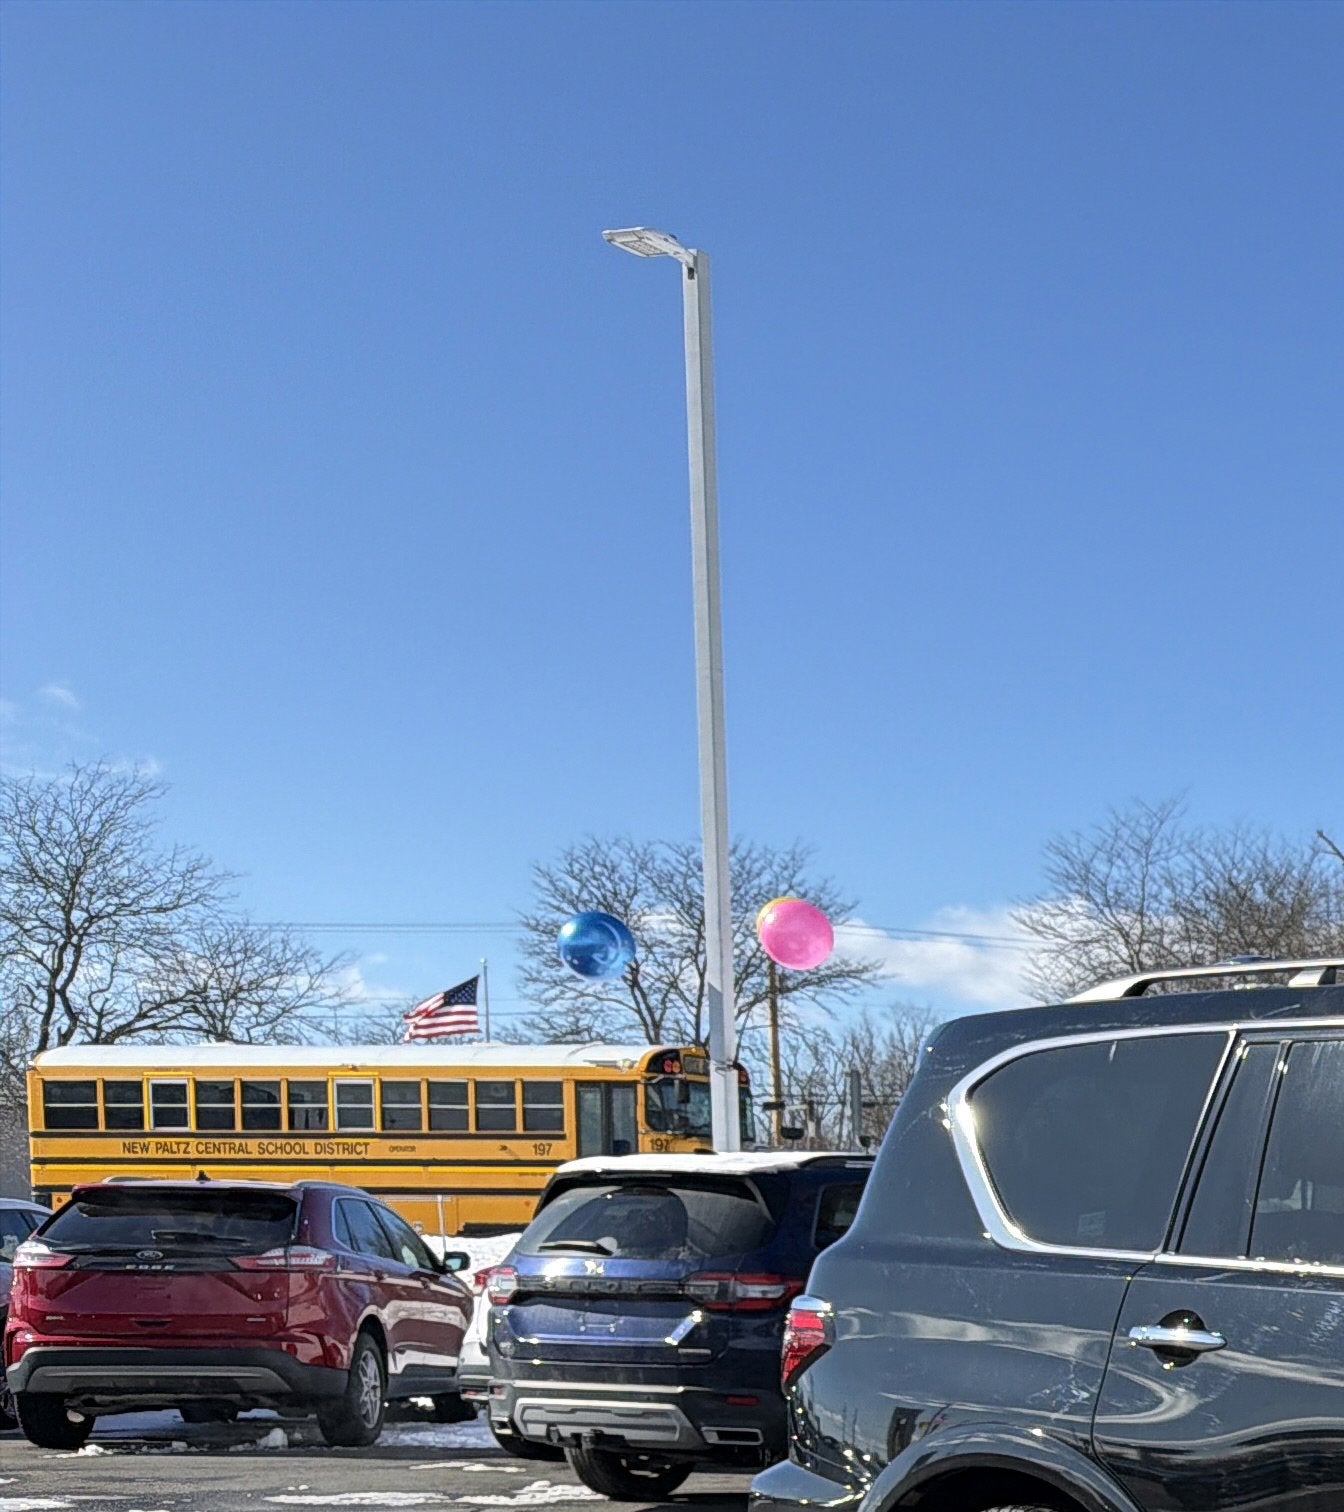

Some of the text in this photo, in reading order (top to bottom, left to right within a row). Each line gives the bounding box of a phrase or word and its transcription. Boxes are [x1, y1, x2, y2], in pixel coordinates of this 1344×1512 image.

[122, 1141, 370, 1156] NEW PALTZ CENTRAL SCHOOL DISTRICT
[533, 1143, 552, 1156] 197
[651, 1138, 671, 1151] 197
